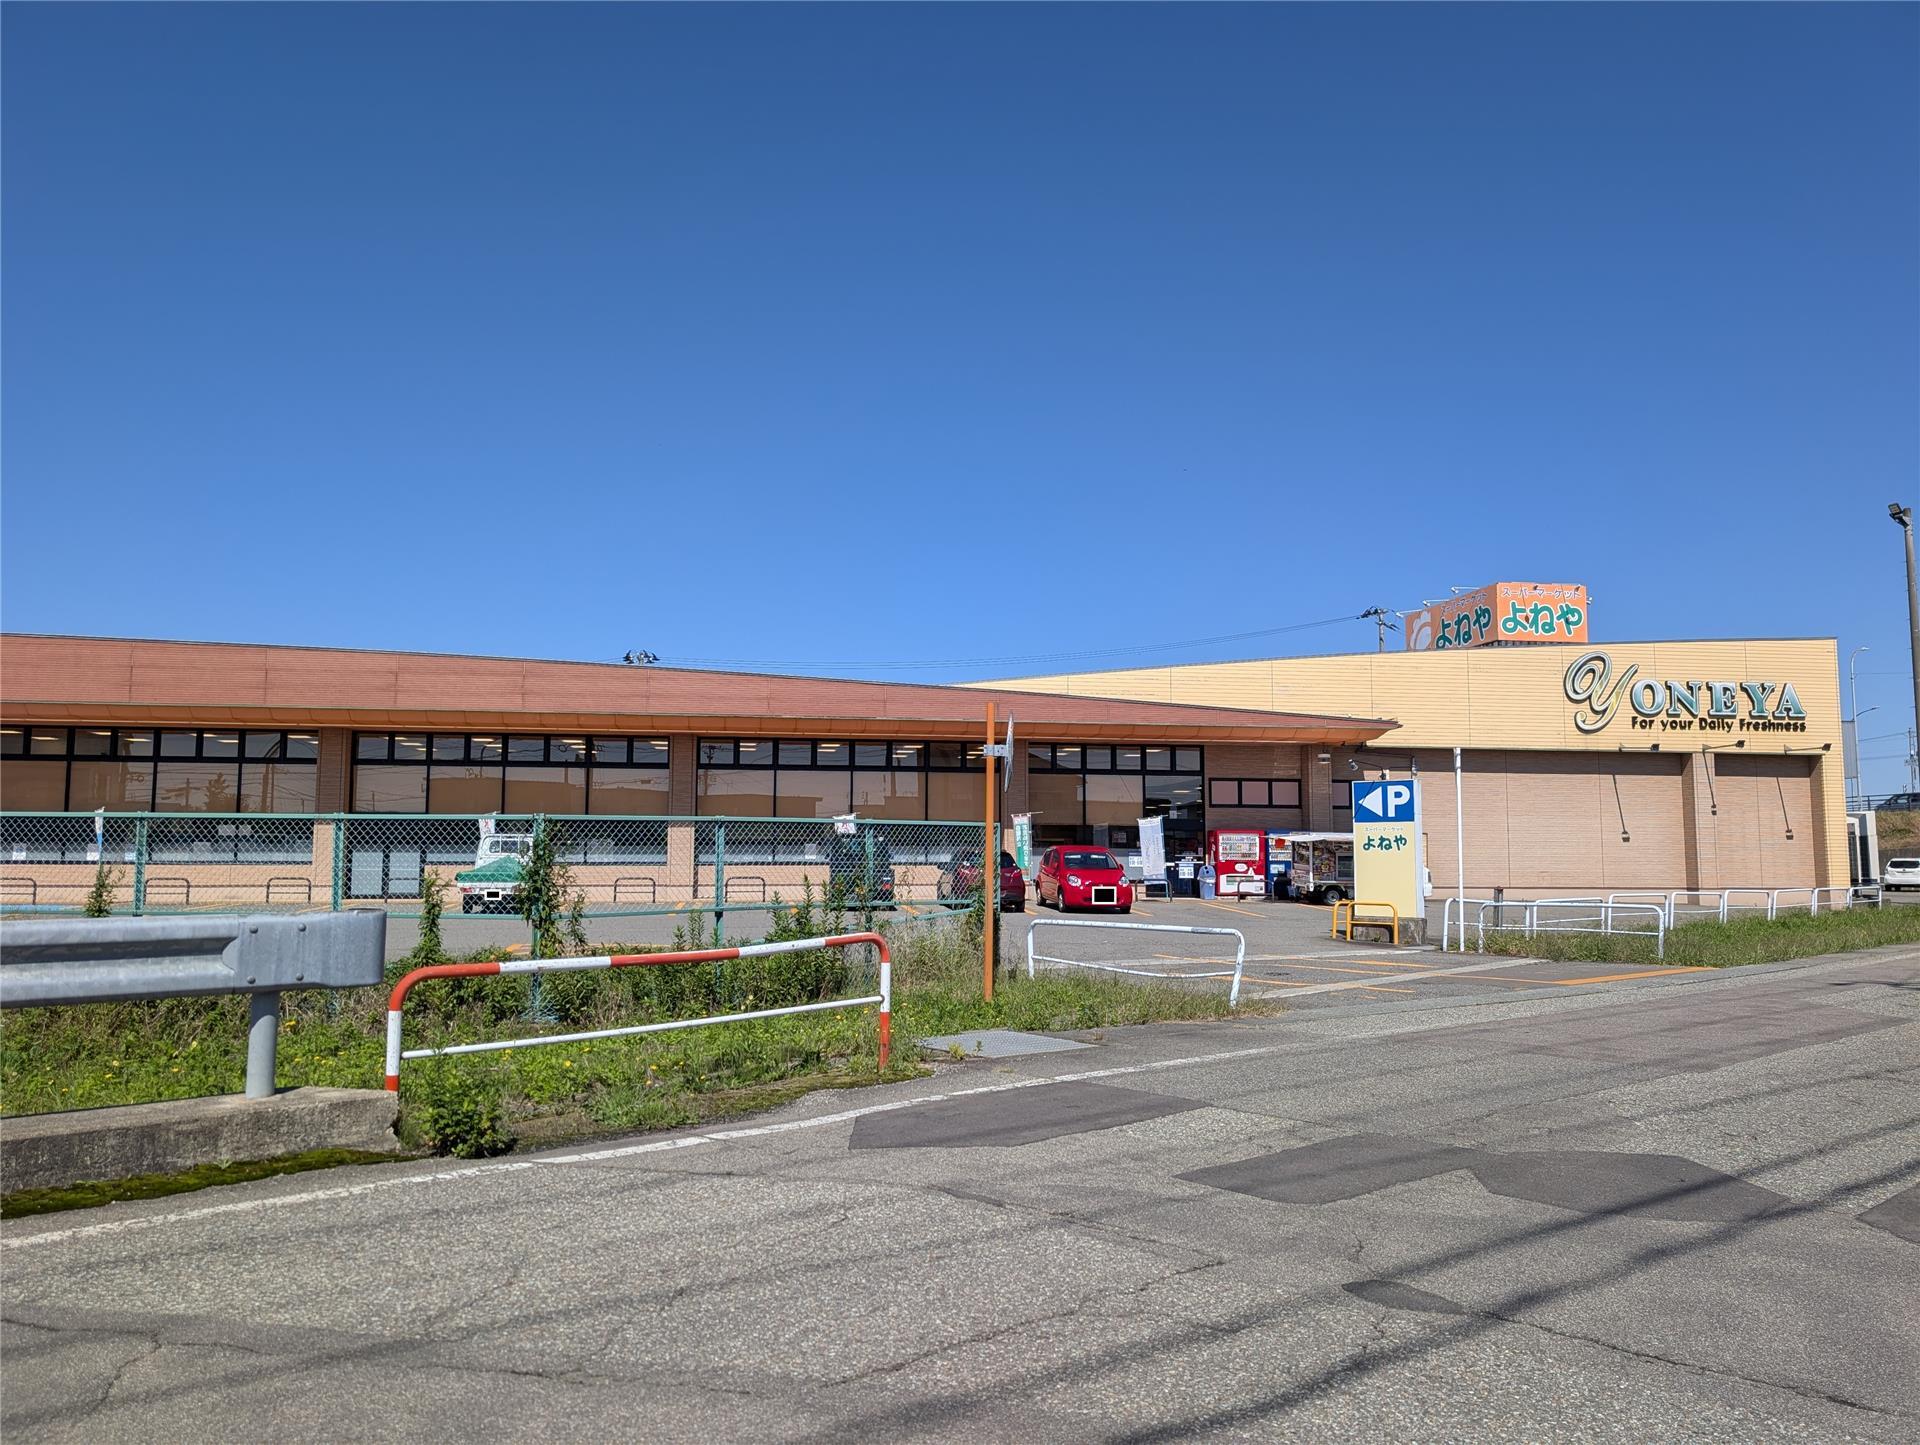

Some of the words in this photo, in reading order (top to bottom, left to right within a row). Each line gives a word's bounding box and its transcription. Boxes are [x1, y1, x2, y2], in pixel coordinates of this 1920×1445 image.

[1503, 587, 1580, 599] スーパーマーケット
[1436, 604, 1492, 648] よねや
[1501, 601, 1583, 635] よねや
[1564, 651, 1807, 733] YONEYA
[1631, 716, 1655, 730] For
[1661, 718, 1694, 732] your
[1699, 717, 1733, 733] Daily
[1739, 718, 1807, 732] Freshness
[1387, 785, 1410, 817] P
[1363, 834, 1407, 851] よねや
